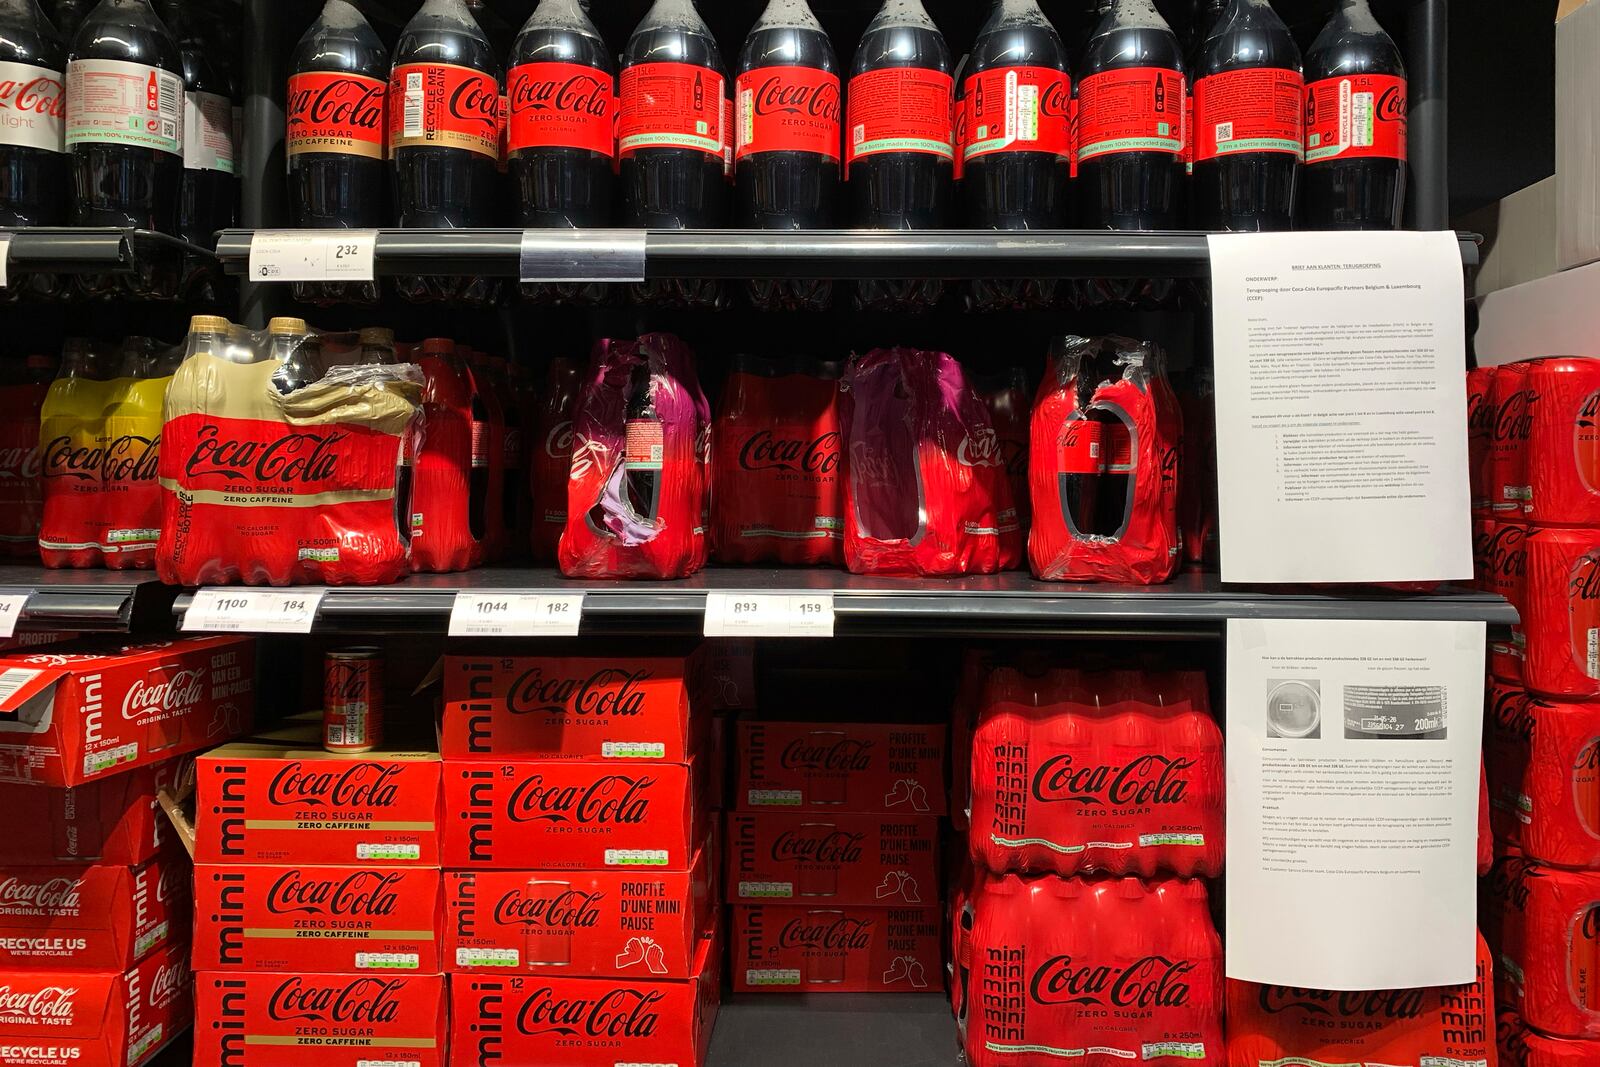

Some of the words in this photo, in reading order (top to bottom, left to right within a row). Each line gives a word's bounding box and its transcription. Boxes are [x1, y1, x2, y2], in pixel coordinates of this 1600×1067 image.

[428, 67, 437, 86] ME
[1019, 71, 1038, 79] 1.5L
[1354, 78, 1373, 86] 1.5L
[436, 68, 446, 104] AGAIN
[511, 73, 609, 117] Coca-Cola
[1, 113, 34, 128] light
[426, 89, 436, 141] RECYCLE
[529, 115, 553, 123] ZERO
[556, 115, 588, 124] SUGAR
[312, 129, 353, 138] SUGAR
[809, 121, 833, 130] SUGAR
[305, 138, 353, 146] CAFFEINE
[185, 425, 352, 482] Coca-Cola
[73, 484, 98, 492] ZERO
[224, 484, 253, 493] ZERO
[256, 485, 294, 494] SUGAR
[177, 489, 187, 517] YOUR
[250, 496, 293, 504] CAFFEINE
[182, 494, 194, 534] BOTTLE
[173, 518, 184, 562] RECYCLE
[313, 537, 340, 546] 500ml
[283, 600, 305, 612] 184
[477, 602, 508, 614] 1044
[546, 602, 569, 615] 182
[734, 602, 758, 613] 893
[799, 603, 821, 615] 159
[122, 667, 207, 720] Coca-Cola
[506, 667, 654, 716] Coca-Cola
[80, 674, 102, 743] mini
[460, 663, 493, 753] mini
[500, 659, 514, 669] 12
[136, 713, 170, 726] ORIGINAL
[172, 707, 192, 718] TASTE
[545, 718, 571, 726] ZERO
[575, 718, 609, 726] SUGAR
[100, 736, 120, 747] 150ml
[780, 738, 876, 770] Coca-Cola
[268, 762, 408, 808] Coca-Cola
[1031, 754, 1197, 806] Coca-Cola
[507, 775, 657, 824] Coca-Cola
[213, 766, 247, 856] mini
[295, 811, 327, 820] ZERO
[332, 812, 373, 820] SUGAR
[460, 770, 494, 861] mini
[500, 766, 515, 777] 12
[1076, 808, 1107, 816] ZERO
[1112, 807, 1151, 816] SUGAR
[545, 826, 573, 834] ZERO
[771, 831, 868, 862] Coca-Cola
[267, 870, 407, 916] Coca-Cola
[621, 882, 665, 897] PROFITE
[48, 908, 79, 917] TASTE
[452, 872, 476, 937] mini
[494, 889, 608, 928] Coca-Cola
[621, 899, 652, 913] D'UNE
[655, 900, 680, 914] MINI
[211, 873, 245, 965] mini
[294, 920, 326, 929] ZERO
[331, 921, 372, 929] SUGAR
[620, 917, 654, 931] PAUSE
[779, 918, 875, 950] Coca-Cola
[67, 938, 86, 950] US
[510, 978, 524, 989] 12
[1029, 955, 1198, 1009] Coca-Cola
[124, 968, 141, 1036] mini
[268, 976, 409, 1023] Coca-Cola
[41, 1017, 72, 1025] TASTE
[516, 987, 668, 1038] Coca-Cola
[985, 1007, 1025, 1025] mini
[1076, 1010, 1107, 1018] ZERO
[1113, 1010, 1153, 1019] SUGAR
[1441, 1007, 1486, 1026] mini
[212, 980, 246, 1067] mini
[295, 1027, 327, 1036] ZERO
[332, 1028, 374, 1036] SUGAR
[985, 1022, 1025, 1040] mini
[1301, 1018, 1335, 1028] ZERO
[1340, 1020, 1383, 1030] SUGAR
[1442, 1024, 1486, 1044] mini
[60, 1048, 80, 1059] US
